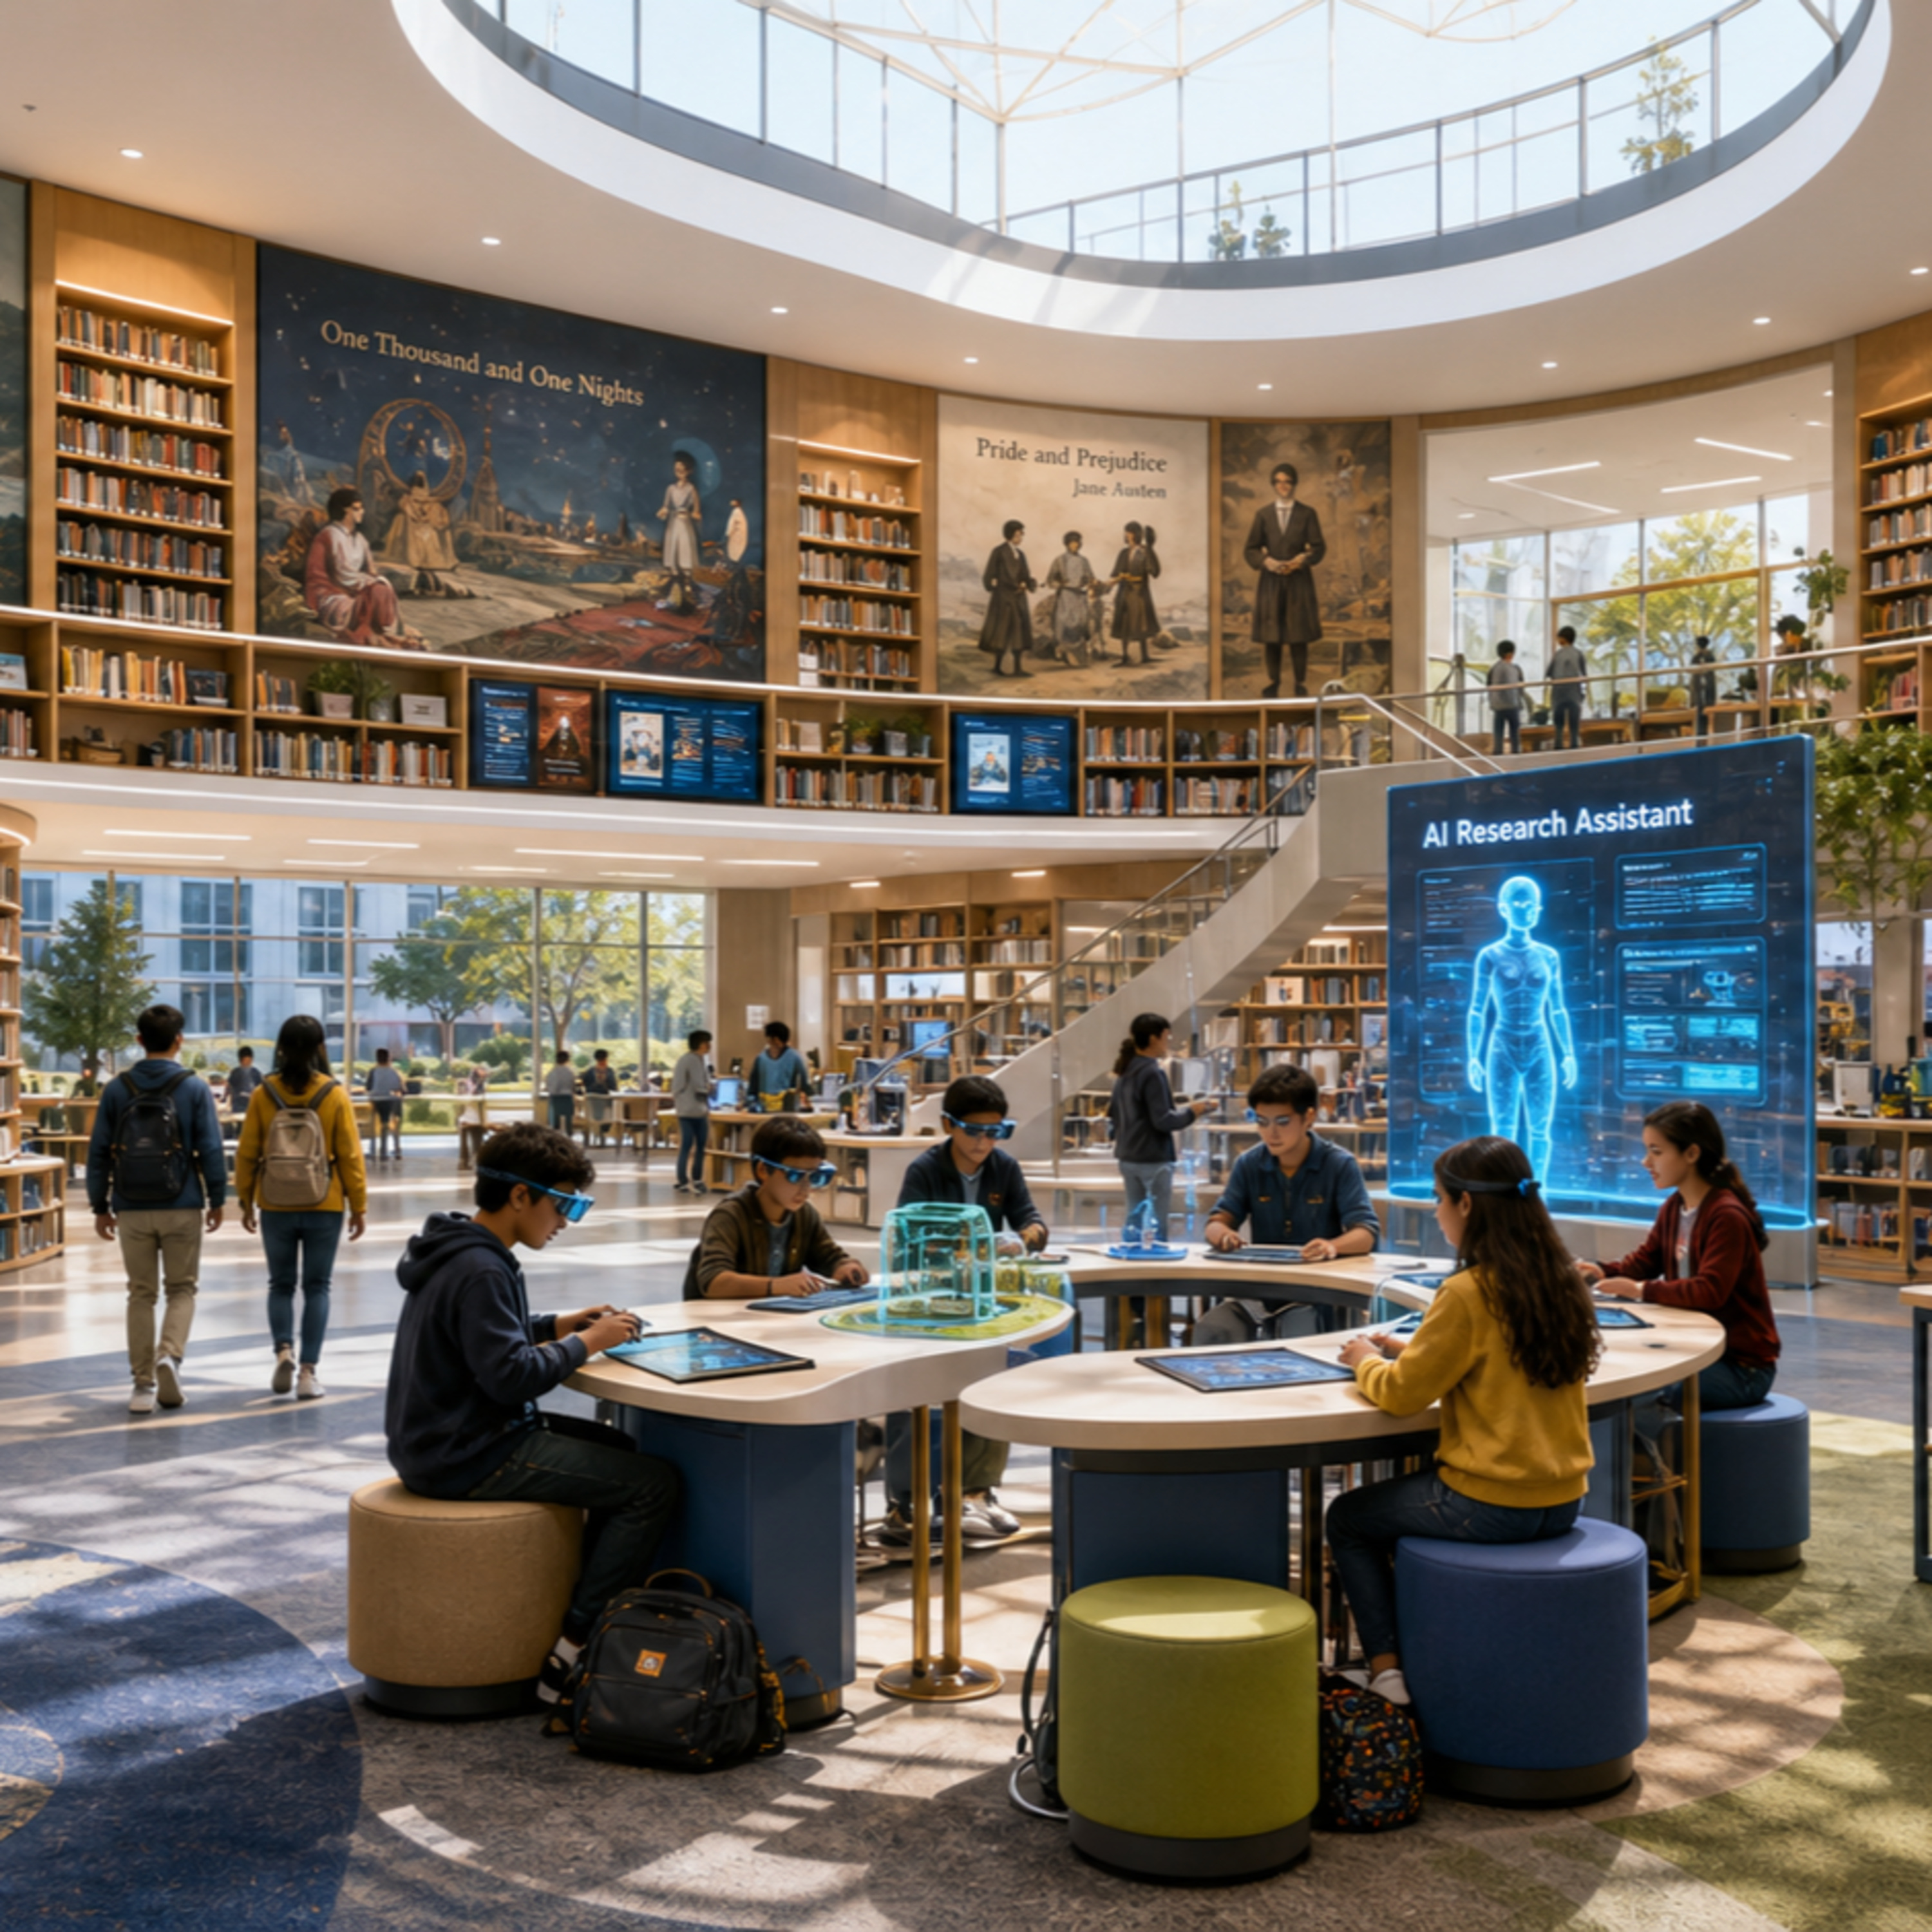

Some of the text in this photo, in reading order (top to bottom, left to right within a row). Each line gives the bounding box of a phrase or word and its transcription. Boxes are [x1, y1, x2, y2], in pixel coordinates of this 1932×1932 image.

[321, 320, 645, 406] One Thousand and One Nights
[976, 437, 1167, 474] Pride and Prejudice
[1072, 478, 1167, 498] Jane Austen
[1423, 799, 1693, 848] AI Research Assistant
